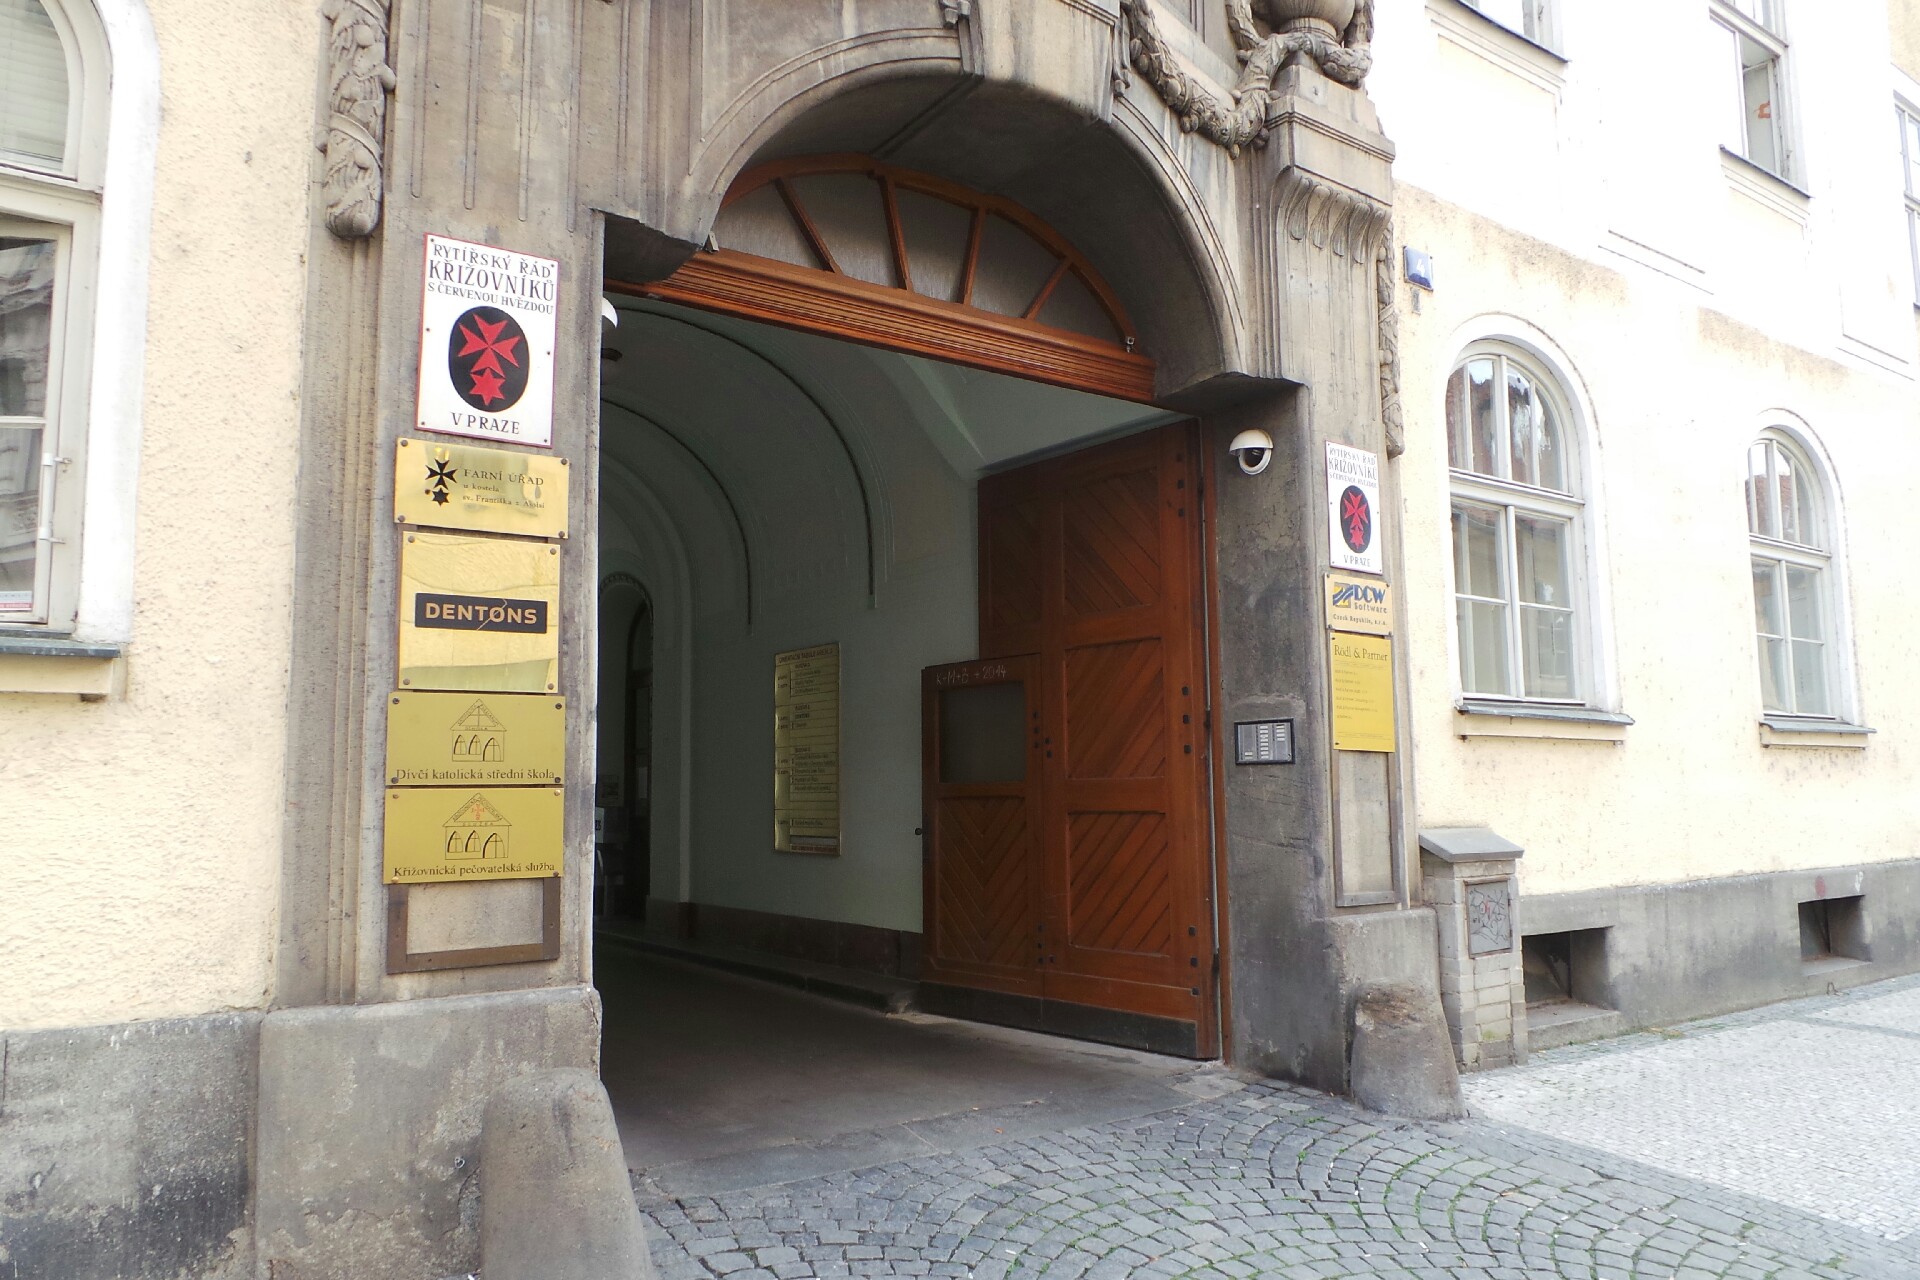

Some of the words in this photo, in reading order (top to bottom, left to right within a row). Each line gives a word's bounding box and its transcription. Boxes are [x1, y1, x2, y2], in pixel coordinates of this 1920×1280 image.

[433, 243, 512, 271] RYTÍŘSKÝ
[519, 257, 552, 279] ŘÁD
[1416, 258, 1425, 277] 4
[429, 258, 555, 302] KŘIŽOVNÍKŮ
[427, 282, 436, 292] S
[437, 281, 499, 305] ČERVENOU
[501, 296, 555, 315] HVĚZDOU
[451, 412, 462, 426] V
[467, 413, 521, 435] PRAZE
[464, 468, 503, 482] FARNÍ
[508, 472, 545, 486] ÚŘAD
[472, 483, 500, 493] kostela
[475, 494, 513, 506] Františka
[1349, 556, 1371, 568] PRAZE
[1354, 584, 1386, 605] DCW
[425, 602, 537, 625] DENTONS
[1354, 602, 1388, 614] Software
[1334, 644, 1352, 657] Rödl
[1354, 647, 1361, 659] &
[1362, 648, 1388, 662] Partner
[396, 768, 429, 780] Dívčí
[432, 768, 483, 780] katolická
[487, 768, 524, 780] střední
[527, 768, 555, 780] škola
[394, 864, 456, 877] Křižovnická
[459, 863, 522, 877] pečovatelská
[525, 862, 555, 873] služba
